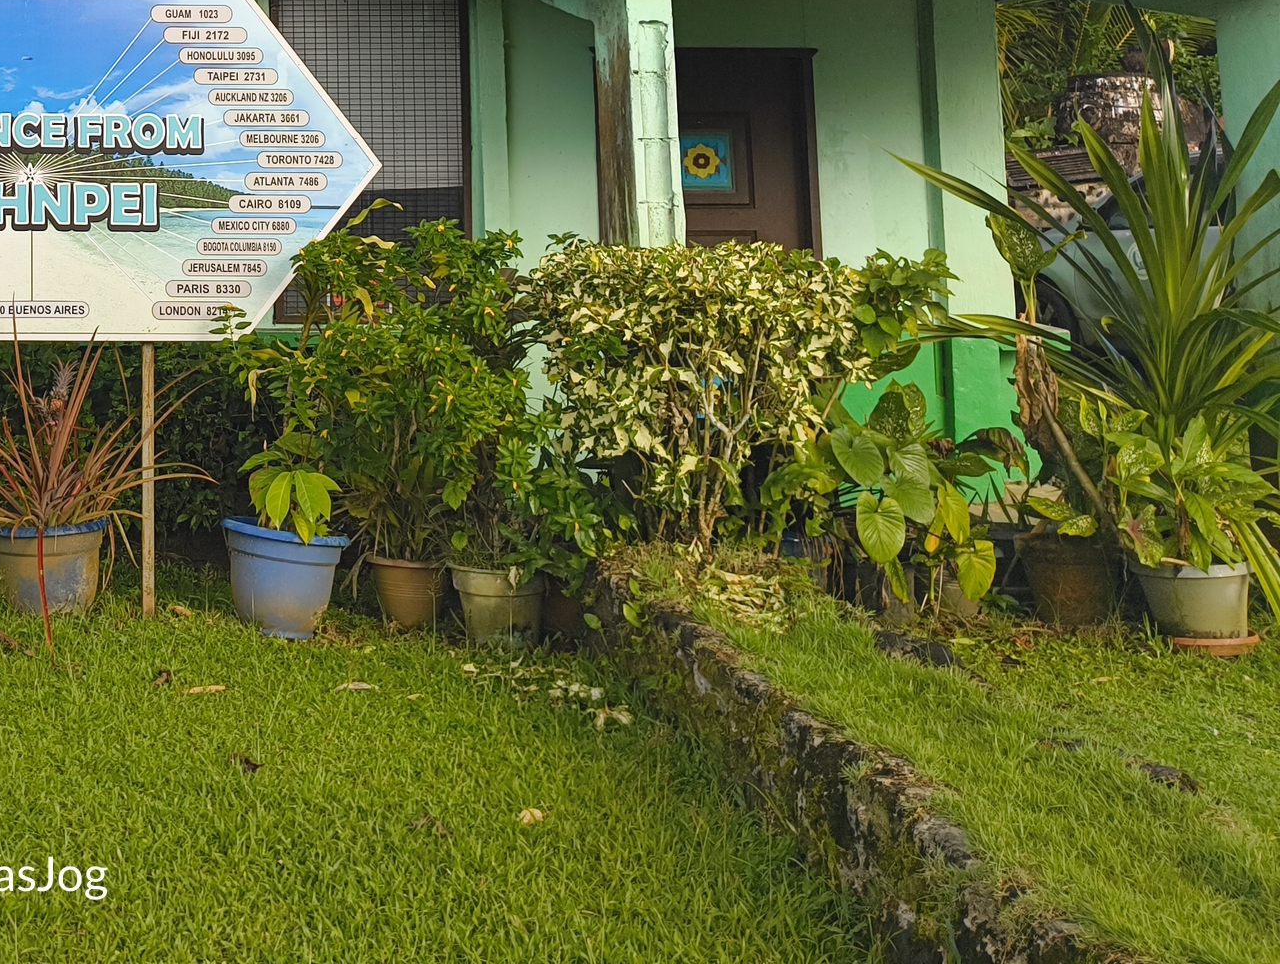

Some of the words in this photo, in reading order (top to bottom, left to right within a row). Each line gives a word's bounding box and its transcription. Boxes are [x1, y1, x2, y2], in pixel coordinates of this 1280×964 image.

[164, 8, 192, 20] GUAM
[198, 8, 219, 20] 1023
[181, 30, 200, 41] FIJI
[205, 30, 230, 41] 2172
[186, 50, 235, 62] HONOLULU
[236, 50, 256, 62] 3095
[206, 71, 239, 82] TAIPEI
[243, 71, 266, 82] 2731
[214, 92, 257, 103] AUCKLAND
[258, 92, 269, 103] NZ
[270, 92, 288, 103] 3206
[233, 113, 277, 124] JAKARTA
[280, 113, 300, 124] 3661
[73, 113, 204, 153] FROM
[246, 134, 299, 145] MELBOURNE
[300, 134, 320, 145] 3206
[265, 154, 312, 165] TORONTO
[313, 154, 335, 165] 7428
[253, 176, 295, 187] ATLANTA
[298, 176, 319, 187] 7486
[238, 198, 273, 209] CAIRO
[277, 198, 302, 209] 8109
[218, 220, 250, 231] MEXICO
[251, 220, 270, 231] CITY
[271, 220, 290, 231] 6880
[203, 241, 229, 252] BOGOTA
[229, 241, 262, 252] COLUMBIA
[262, 241, 277, 252] 8150
[187, 263, 240, 274] JERUSALEM
[241, 263, 262, 274] 7845
[176, 283, 210, 294] PARIS
[215, 283, 241, 294] 8330
[8, 305, 52, 316] BUENOS
[53, 305, 86, 316] AIRES
[159, 305, 201, 316] LONDON
